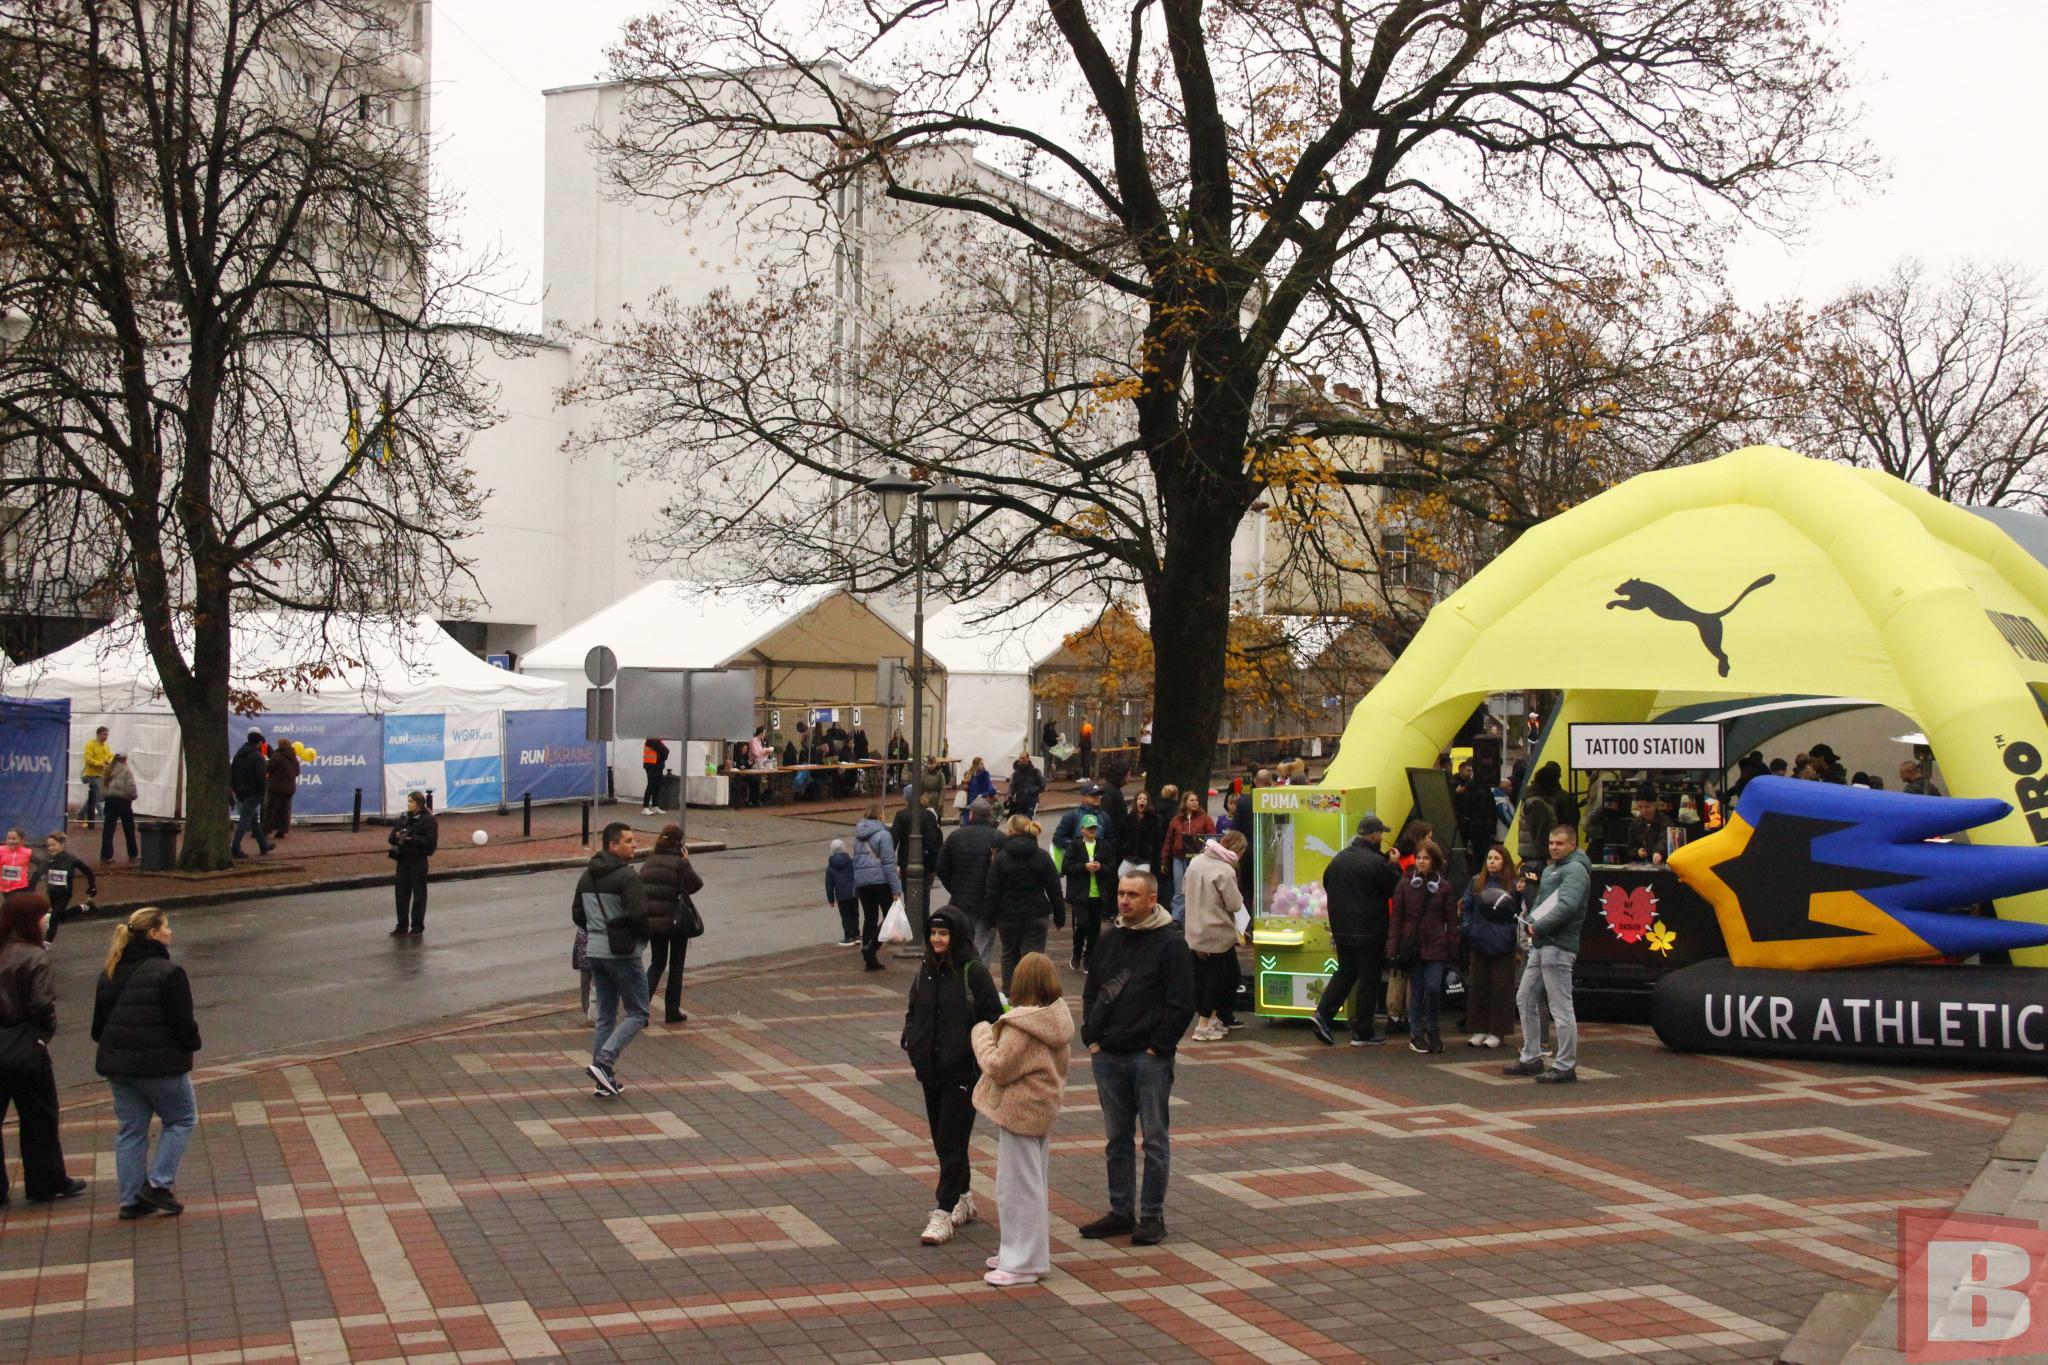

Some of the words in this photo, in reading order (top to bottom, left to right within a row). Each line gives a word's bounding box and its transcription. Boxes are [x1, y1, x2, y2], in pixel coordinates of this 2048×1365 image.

[1584, 738, 1639, 755] TATTOO
[1643, 738, 1705, 755] STATION
[520, 749, 545, 765] RUN
[1261, 793, 1299, 809] PUMA
[1704, 994, 1797, 1040] UKR
[1812, 998, 2045, 1052] ATHLETIC
